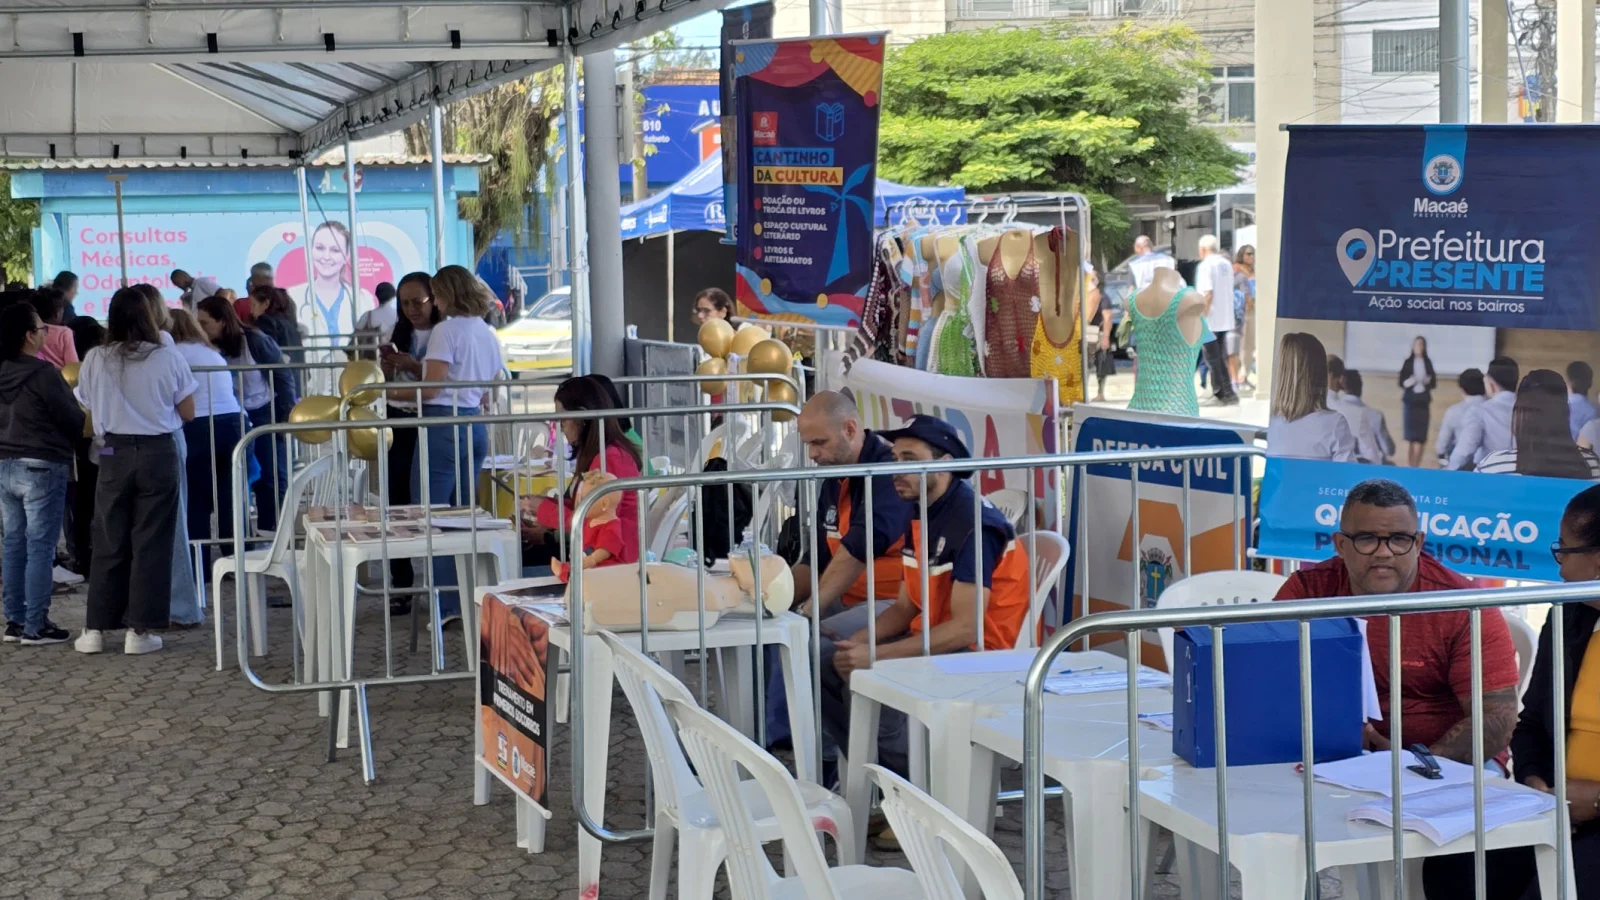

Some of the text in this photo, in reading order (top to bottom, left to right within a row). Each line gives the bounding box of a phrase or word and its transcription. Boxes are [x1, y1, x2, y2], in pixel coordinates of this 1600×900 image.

[756, 151, 830, 164] CANTINHO
[756, 169, 839, 184] DA CULTURA
[762, 195, 806, 207] DOAÇÃO OU
[1413, 197, 1469, 214] Macaé
[763, 206, 826, 216] TROCA DE LIVROS
[763, 221, 828, 232] ESPAÇO CULTURAL
[763, 230, 801, 240] LITERÁRIO
[764, 246, 788, 255] LIVROS
[1377, 228, 1546, 264] Prefeitura
[764, 256, 813, 266] ARTESANATOS
[1367, 260, 1545, 292] PRESENTE
[1368, 295, 1525, 314] Ação social nos bairros
[1169, 455, 1227, 480] CVIL
[1435, 496, 1449, 506] DE
[1314, 503, 1539, 546] QICAÇÃO
[1315, 532, 1531, 571] PSIONAL
